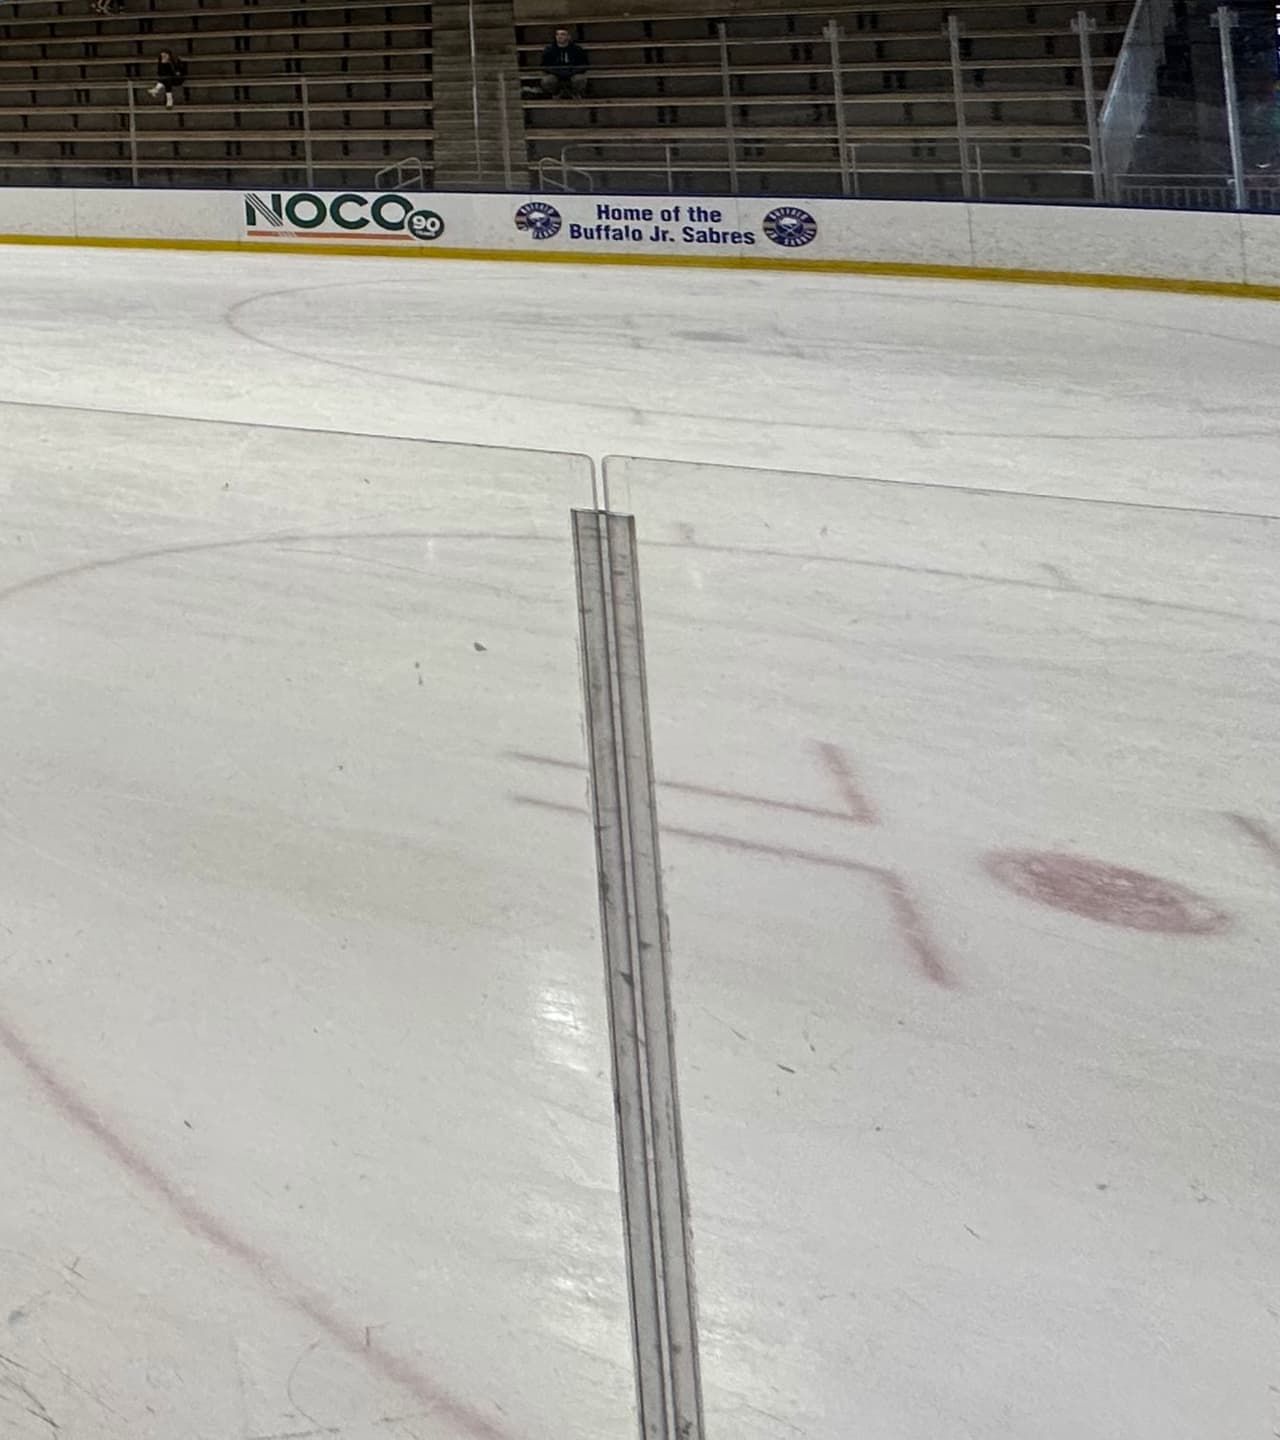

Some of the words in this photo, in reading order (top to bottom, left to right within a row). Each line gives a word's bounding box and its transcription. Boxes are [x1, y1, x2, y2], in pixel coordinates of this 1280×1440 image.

[244, 192, 414, 232] NOCO
[596, 204, 653, 221] Home
[660, 206, 681, 222] of
[687, 206, 722, 223] the
[412, 215, 441, 231] 90
[569, 223, 643, 241] Buffalo
[650, 225, 675, 243] Jr.
[682, 226, 756, 245] Sabres
